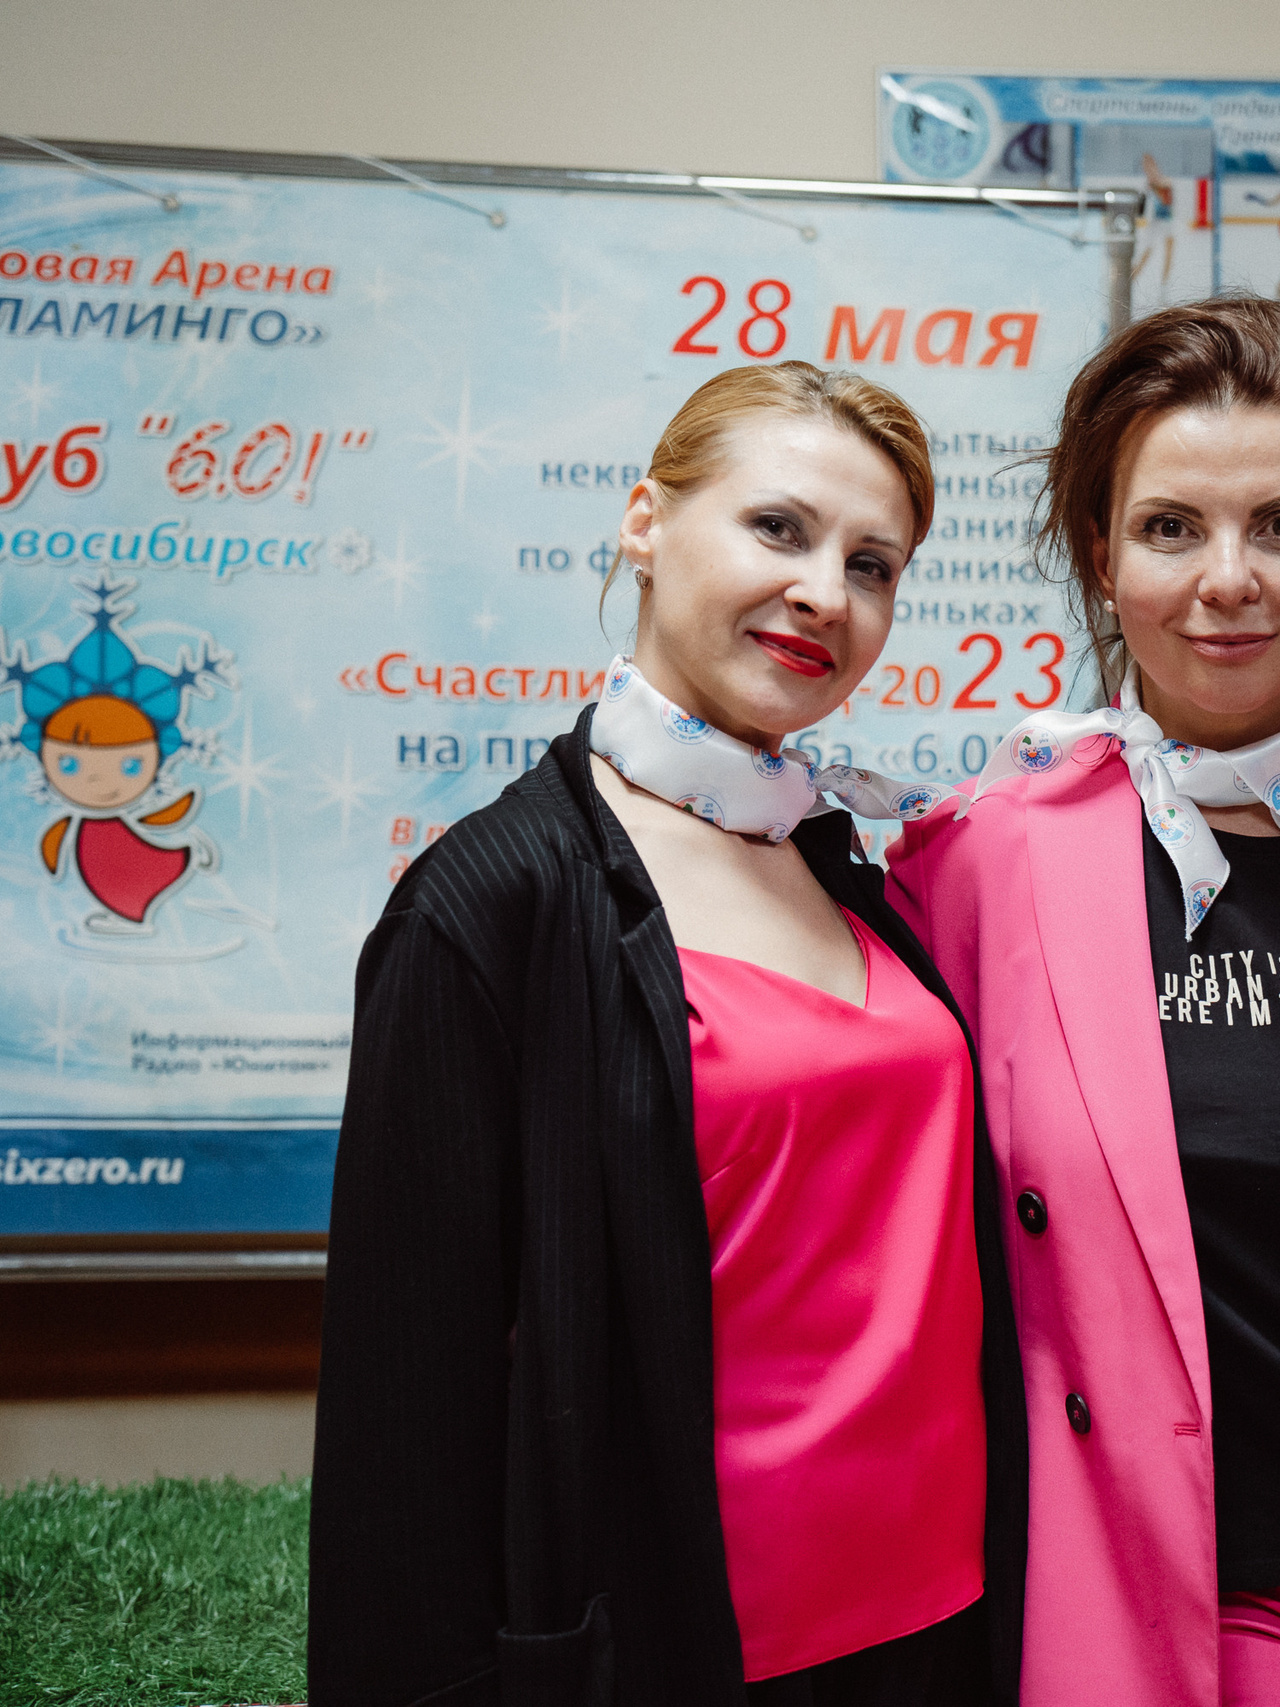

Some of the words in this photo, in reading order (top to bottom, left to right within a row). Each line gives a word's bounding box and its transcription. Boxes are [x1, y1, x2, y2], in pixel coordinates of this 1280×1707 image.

[151, 249, 335, 300] Арена
[672, 275, 791, 359] 28
[822, 305, 1040, 369] мая
[0, 521, 313, 578] восибирск
[520, 547, 570, 572] по
[399, 735, 460, 766] на
[1189, 949, 1254, 980] CITY
[1164, 972, 1264, 1004] URBAN
